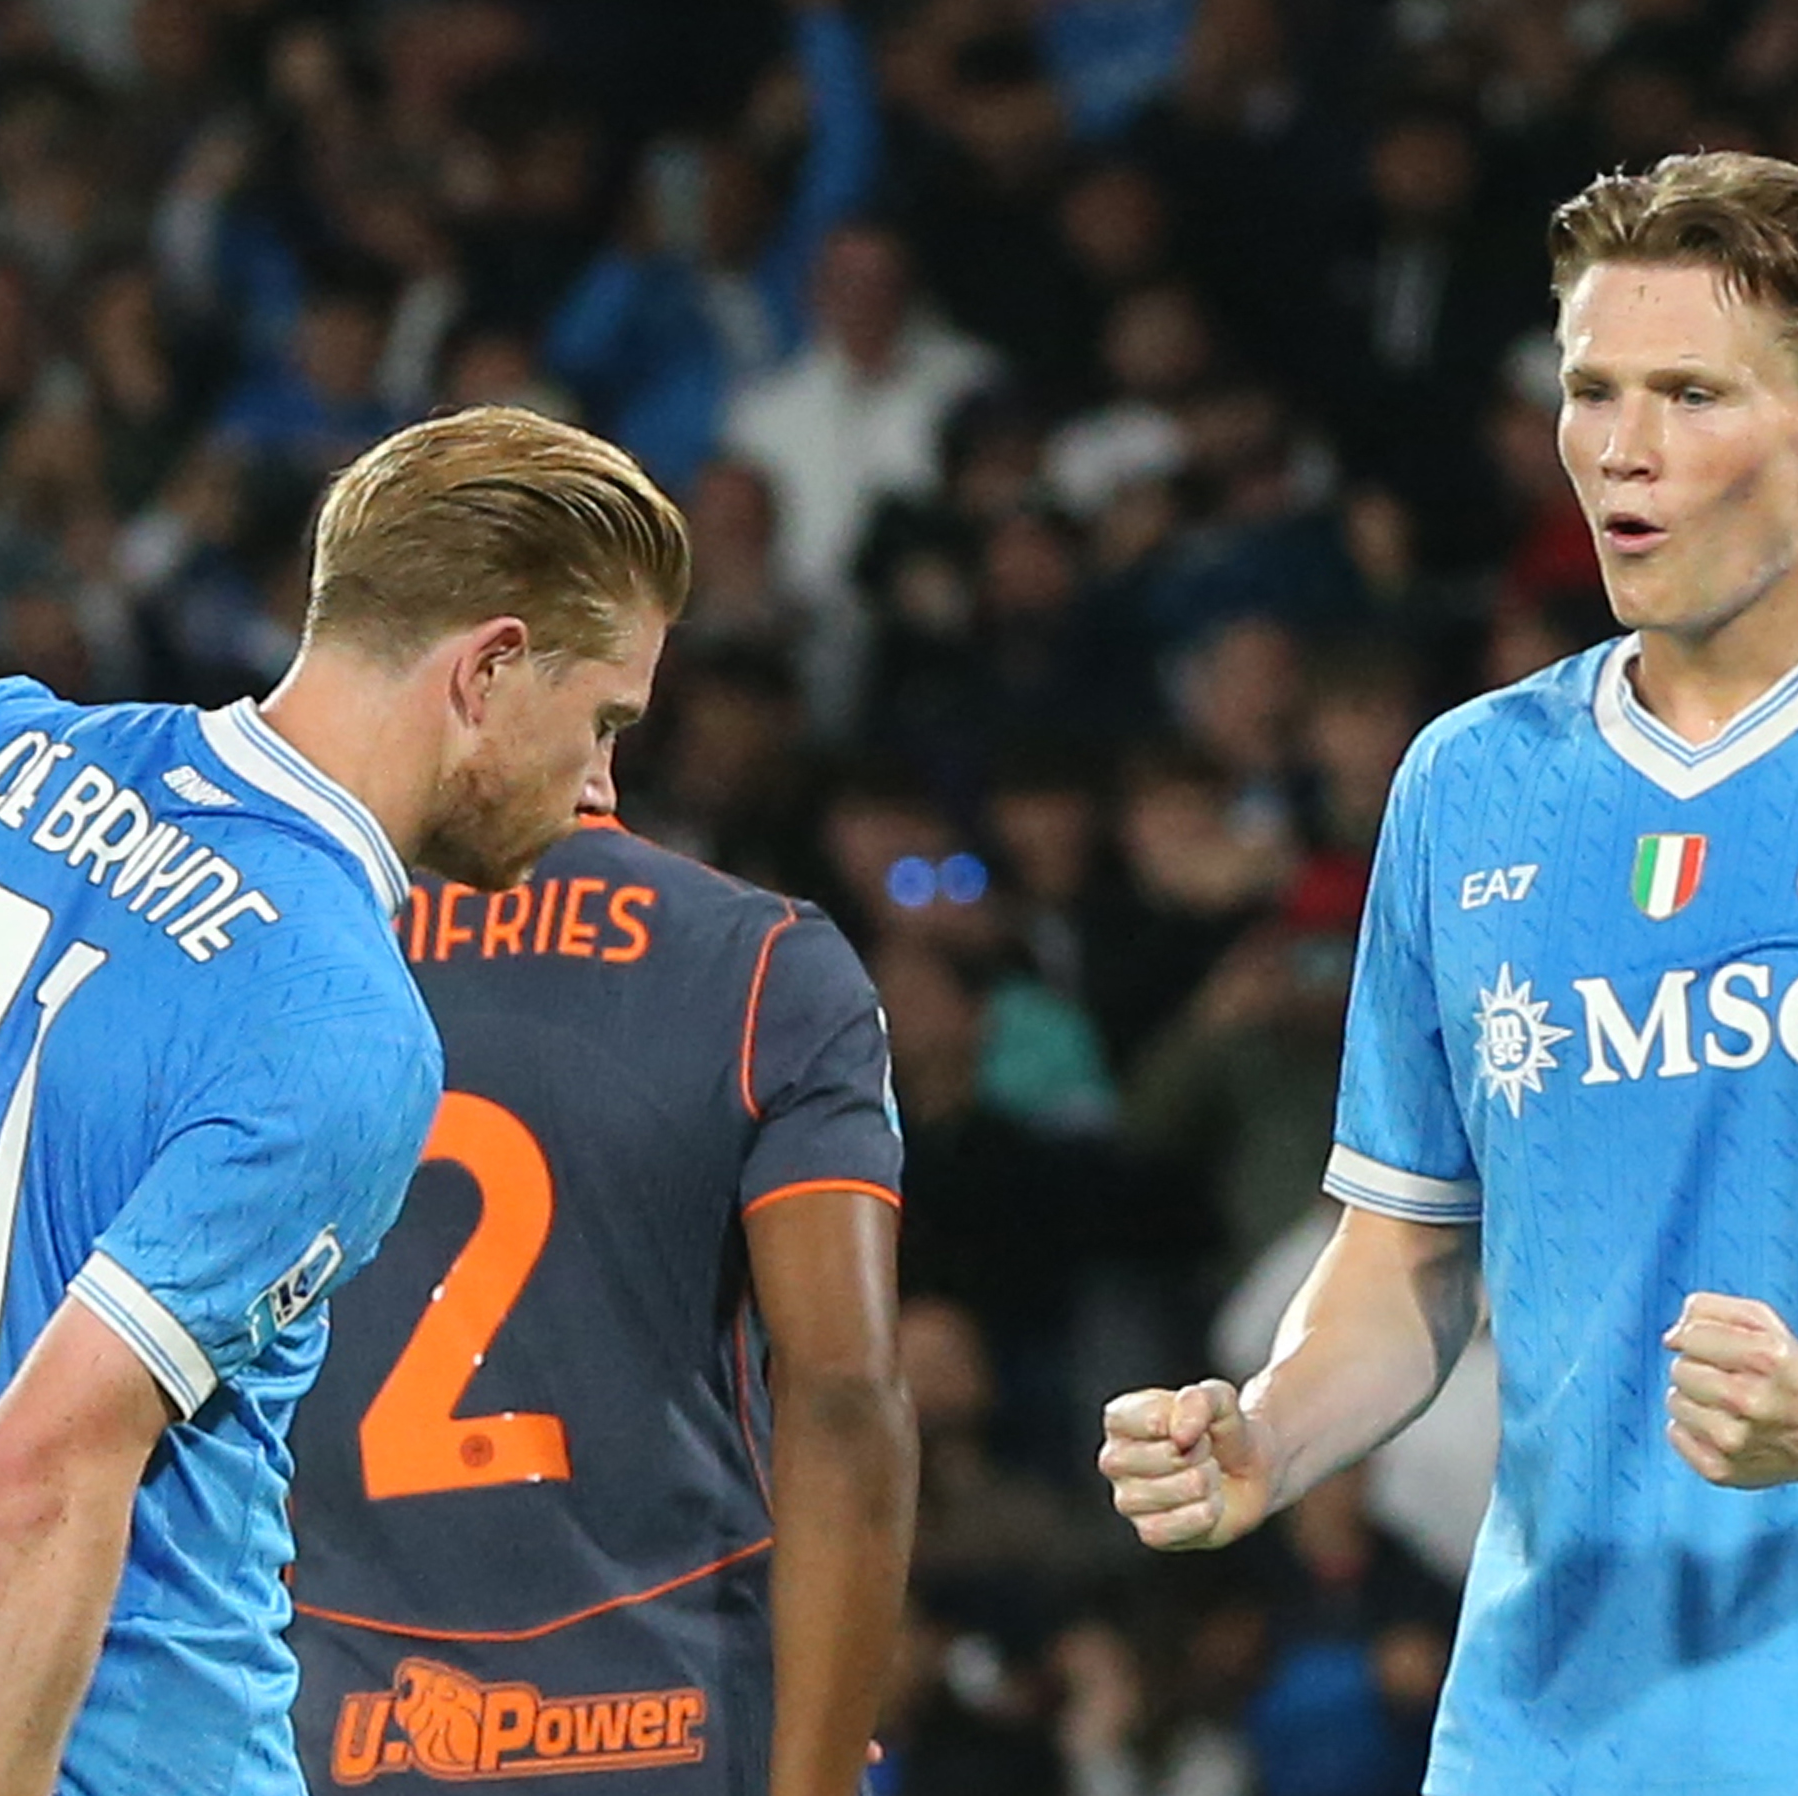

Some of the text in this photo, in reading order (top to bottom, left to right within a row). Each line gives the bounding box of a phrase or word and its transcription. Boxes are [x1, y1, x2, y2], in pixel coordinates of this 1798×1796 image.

[31, 764, 280, 962] BRUYNE
[1460, 864, 1539, 911] EA7
[358, 1090, 573, 1500] 2
